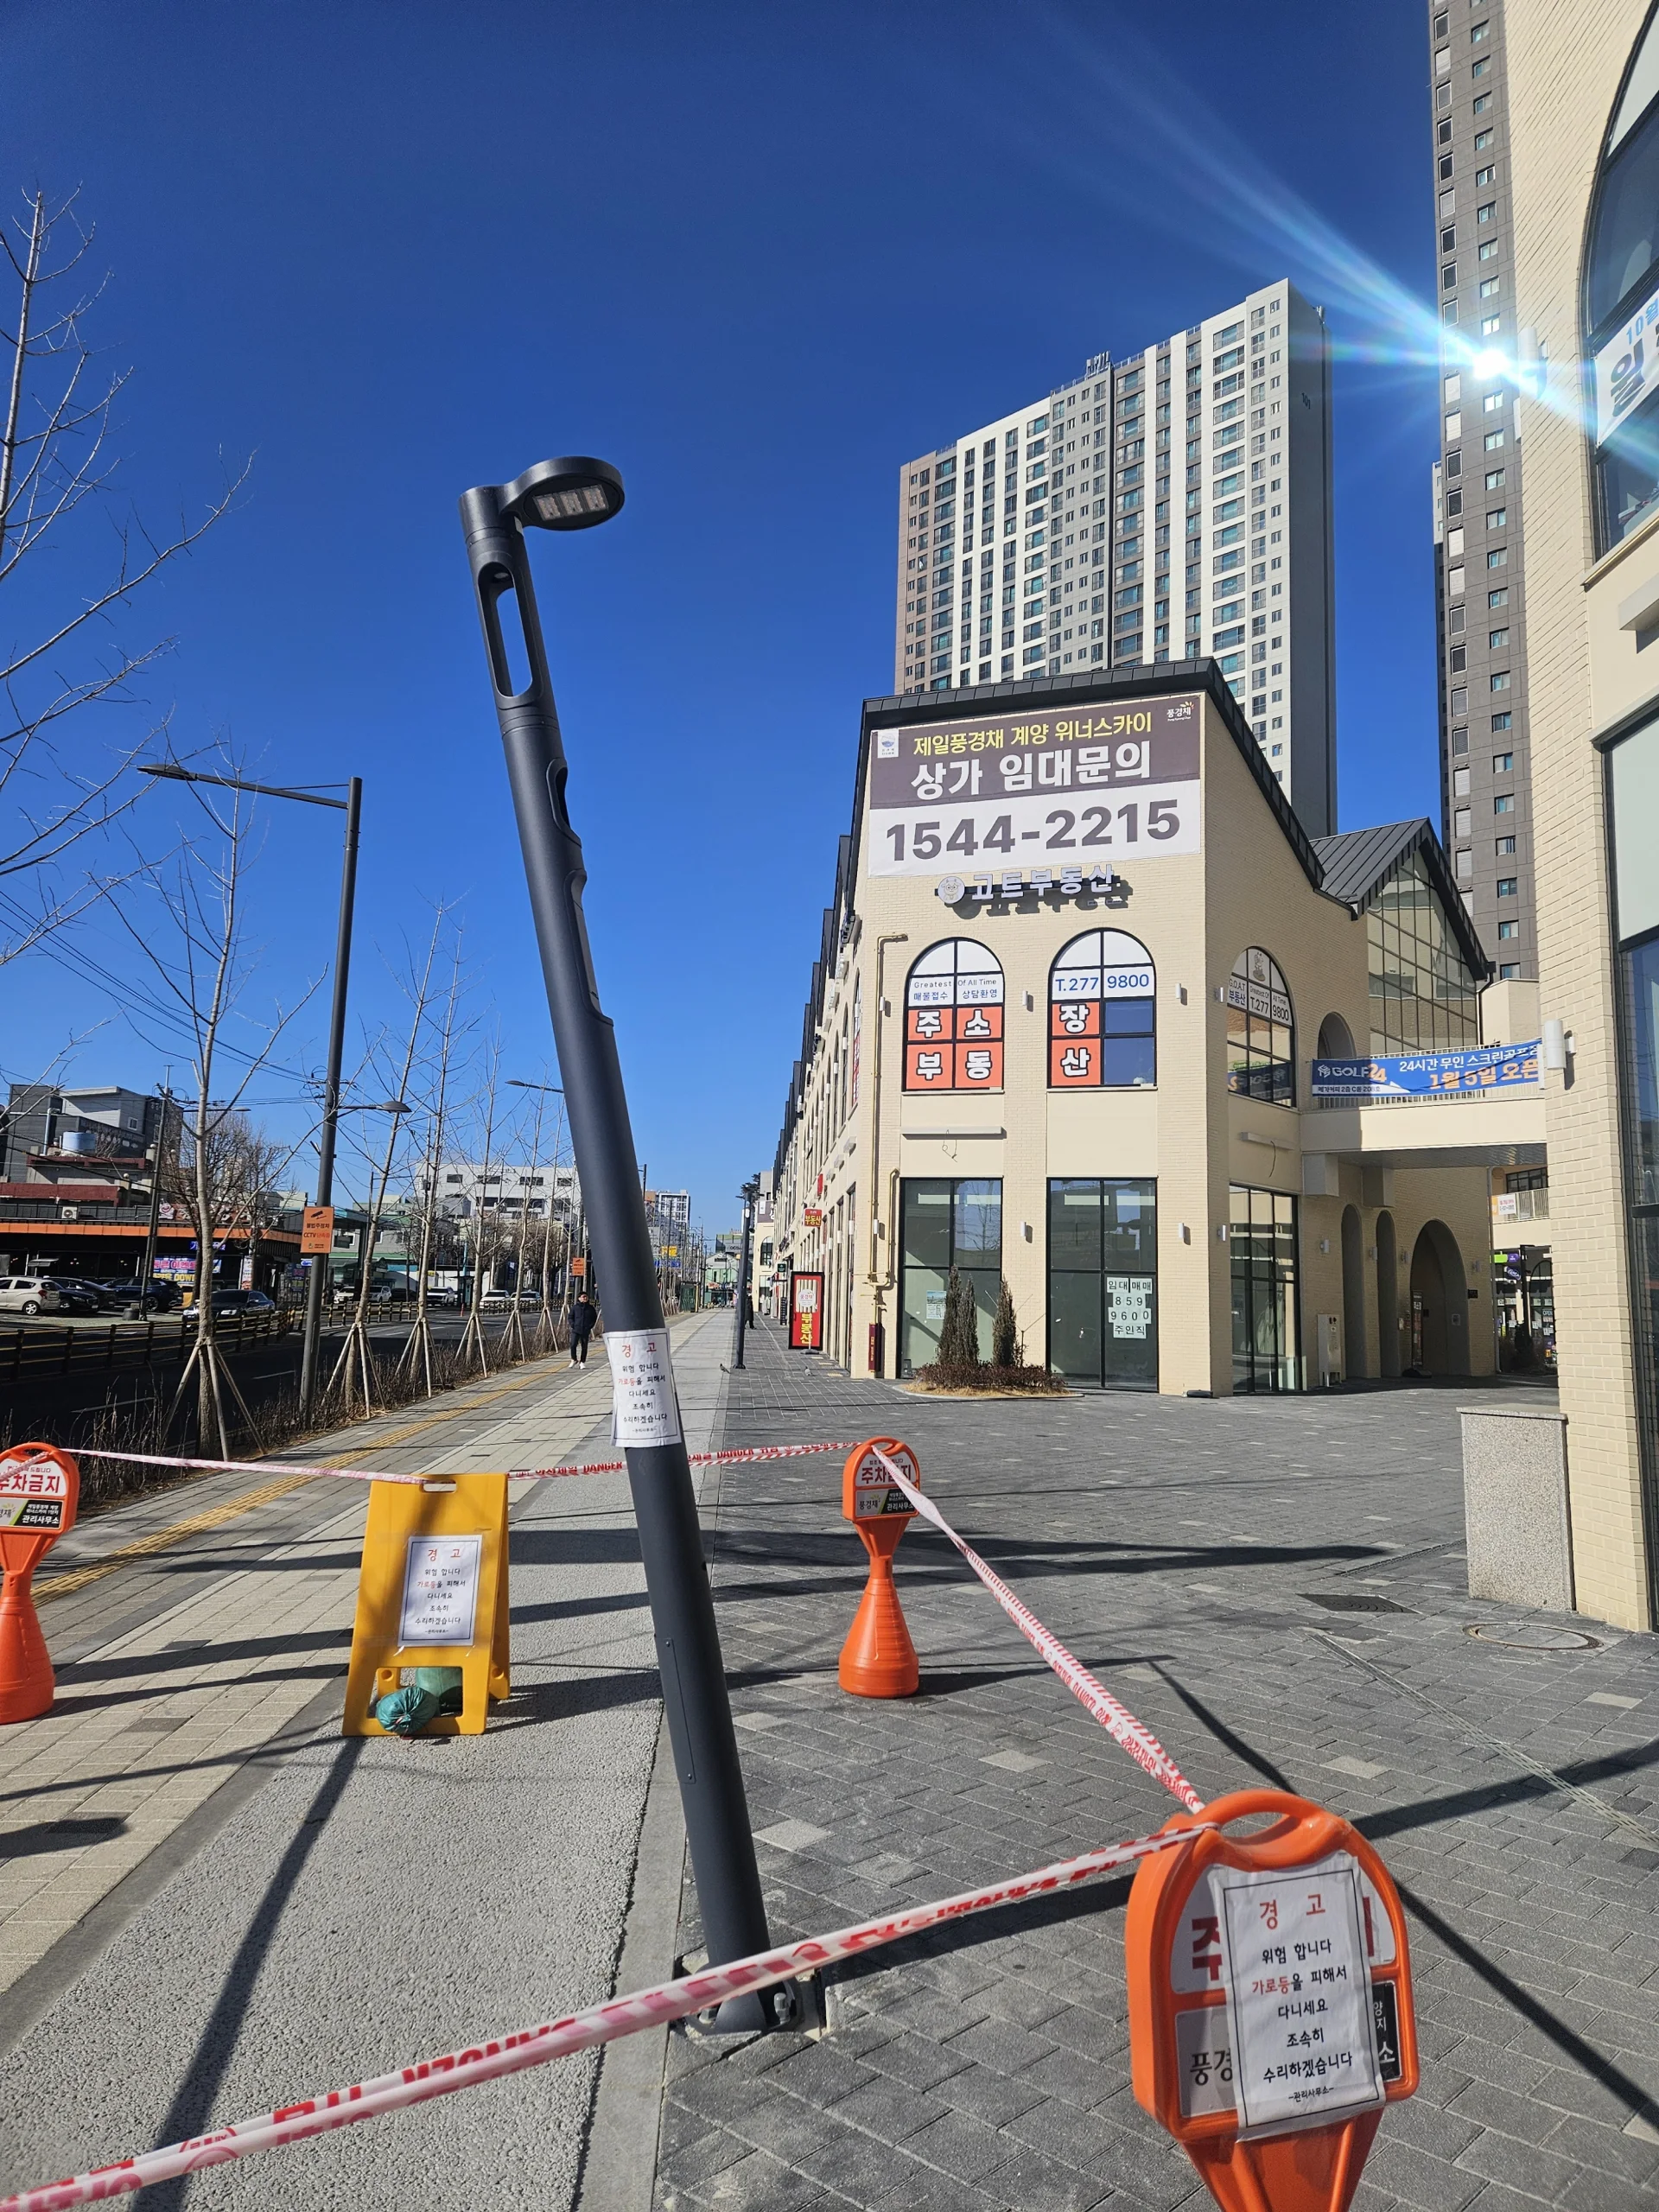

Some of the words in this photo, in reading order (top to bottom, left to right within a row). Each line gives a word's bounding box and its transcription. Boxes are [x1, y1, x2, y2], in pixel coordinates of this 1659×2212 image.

[1166, 707, 1192, 718] 풍경채
[913, 727, 1004, 757] 제일풍경채
[1011, 723, 1049, 747] 계양
[1055, 711, 1153, 741] 위너스카이
[911, 758, 983, 801] 상가
[1000, 740, 1151, 792] 임대문의
[886, 799, 1180, 861] 1544-2215
[971, 864, 1115, 900] 고트부동산
[914, 980, 952, 988] Greatest
[978, 977, 997, 986] Time
[1055, 977, 1099, 992] T.277
[1107, 974, 1149, 989] 9800
[913, 991, 948, 1001] 매물접수
[962, 988, 998, 1000] 상담환영
[1229, 988, 1246, 1007] 부동산
[1249, 996, 1269, 1014] T.277
[1272, 1004, 1289, 1021] 9800
[1399, 1058, 1438, 1072] 24시간
[1440, 1056, 1464, 1070] 무인
[1429, 1071, 1460, 1090] 1월
[1465, 1066, 1497, 1086] 5일
[1501, 1058, 1539, 1081] 오픈
[805, 1215, 822, 1225] 부동산
[1108, 1281, 1128, 1290] 임대
[1131, 1281, 1151, 1291] 매매
[1115, 1296, 1143, 1306] 859
[1110, 1310, 1149, 1320] 9600
[1115, 1325, 1145, 1336] 주인직
[639, 1363, 659, 1372] 합니다
[628, 1389, 657, 1397] 다니세요
[582, 1461, 622, 1473] DANGER
[859, 1499, 879, 1510] 풍경채
[22, 1515, 60, 1524] 관리사무소
[424, 1568, 437, 1577] 위험
[1262, 1945, 1287, 1965] 위험
[1294, 1938, 1332, 1961] 합니다
[1252, 1972, 1302, 1996] 가로등을
[1311, 1966, 1348, 1986] 피해서
[1278, 1997, 1329, 2020] 다니세요
[1286, 2028, 1325, 2049] 조속히
[1189, 2051, 1234, 2087] 풍경
[1263, 2052, 1353, 2082] 수리하겠습니다
